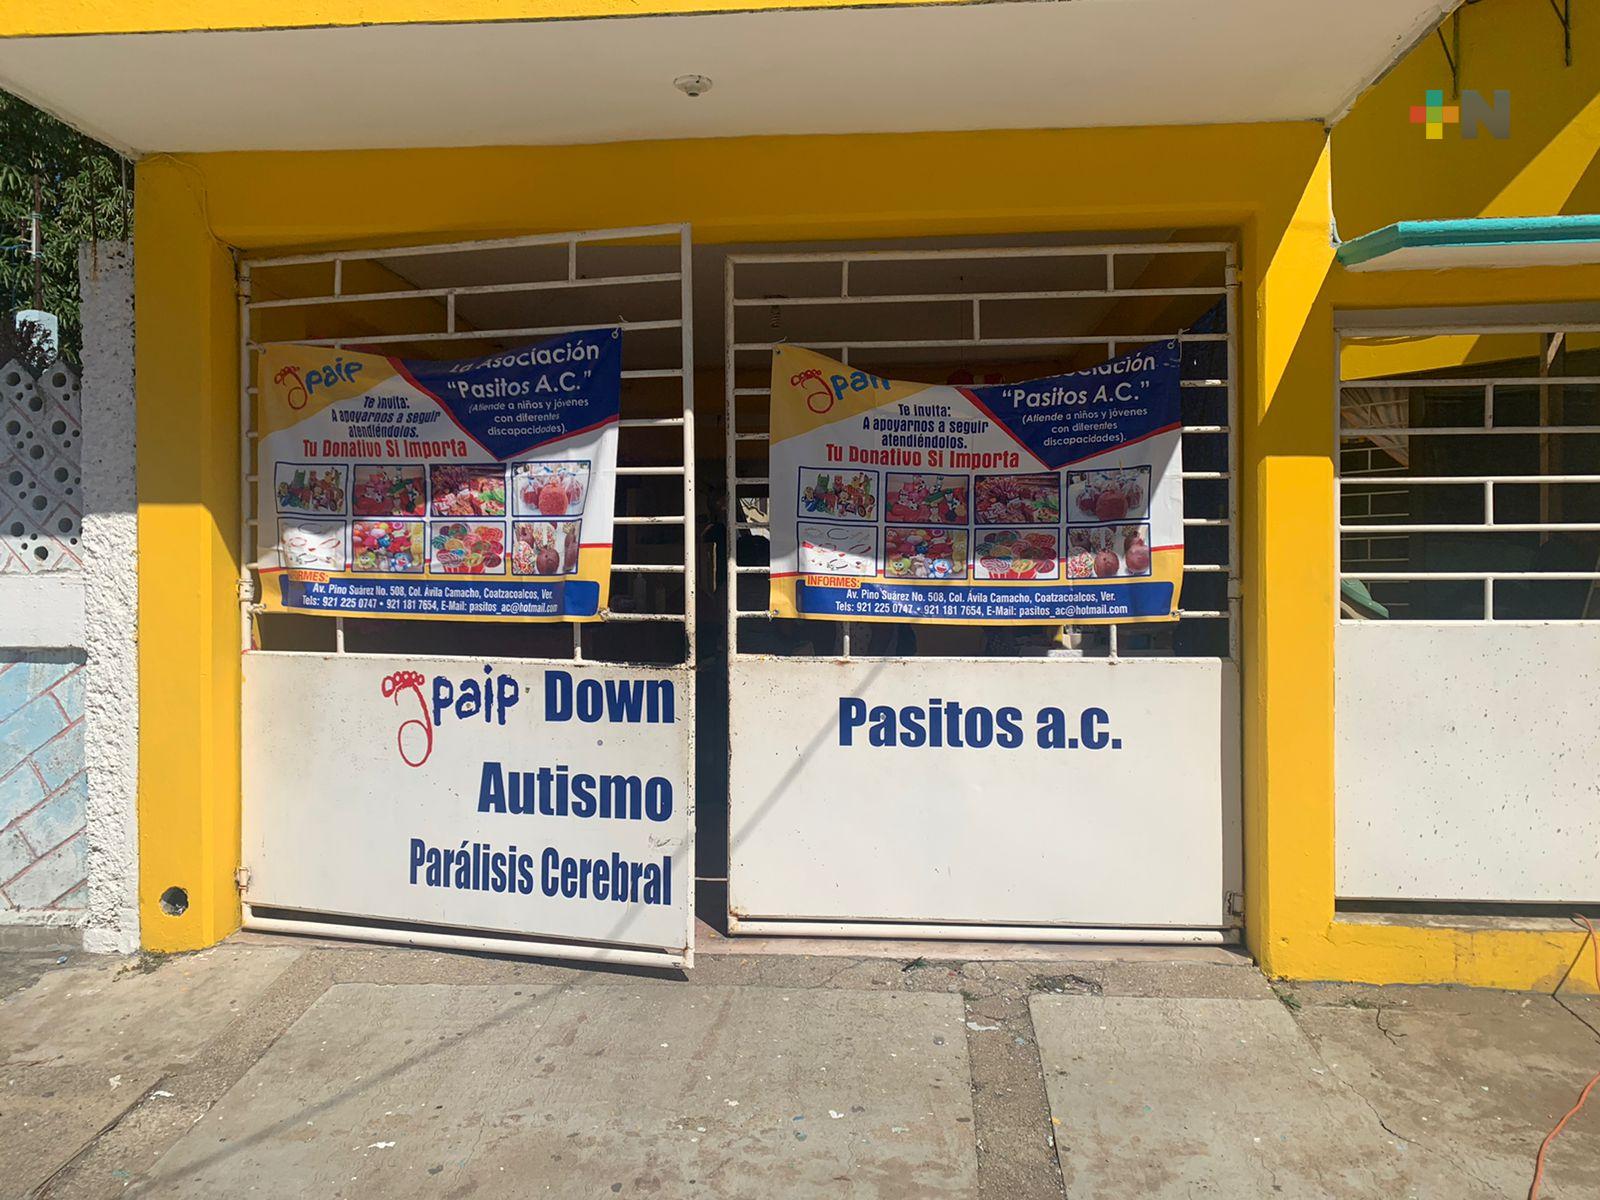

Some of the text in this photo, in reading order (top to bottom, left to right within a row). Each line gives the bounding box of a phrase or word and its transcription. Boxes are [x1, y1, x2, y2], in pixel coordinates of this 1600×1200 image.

[476, 340, 600, 370] Asociación
[363, 396, 374, 408] Te
[508, 402, 515, 410] a
[517, 399, 543, 410] niños
[545, 401, 551, 410] y
[553, 397, 589, 410] jóvenes
[898, 403, 951, 417] Te invita:
[331, 408, 441, 425] A apoyarnos a seguir
[494, 412, 560, 423] con diferentes
[1066, 413, 1072, 421] a
[1074, 409, 1099, 420] niños
[1101, 411, 1107, 420] y
[1109, 407, 1148, 419] jóvenes
[862, 416, 989, 435] A apoyarnos a seguir
[1051, 421, 1118, 434] con diferentes
[303, 439, 318, 457] Tu
[322, 439, 382, 458] Donativo
[405, 438, 468, 459] Importa
[881, 433, 967, 449] atendiéndolos.
[826, 444, 843, 462] Tu
[849, 445, 922, 467] Donativo
[950, 450, 1019, 471] Importa
[807, 576, 860, 588] INFORMES:
[312, 582, 326, 594] Av.
[328, 583, 347, 595] Pino
[348, 584, 374, 596] Suárez
[376, 586, 388, 596] No.
[390, 586, 407, 598] 508,
[408, 586, 421, 598] Col.
[424, 584, 443, 598] Ávila
[444, 586, 482, 599] Camacho,
[483, 587, 540, 601] Coatzacoalcos,
[846, 588, 1115, 604] Av. Pino Suárez No. 508, Col. Ávila Camacho, Coatzacoalcos, Ver.
[302, 594, 320, 606] Tels:
[322, 596, 338, 607] 921
[340, 597, 356, 608] 225
[358, 598, 377, 609] 0747
[386, 599, 400, 609] 921
[403, 599, 416, 610] 181
[418, 600, 439, 612] 7654,
[441, 600, 467, 612] E-Mail:
[835, 601, 1128, 618] Tels: 921 225 0747 921 181 7654, E-Mail: pasitos_ac@hotmail.com
[544, 670, 676, 724] Down
[838, 697, 1123, 750] Pasitos a.c.
[477, 761, 673, 822] Autismo
[409, 838, 672, 906] Parálisis Cerebral
